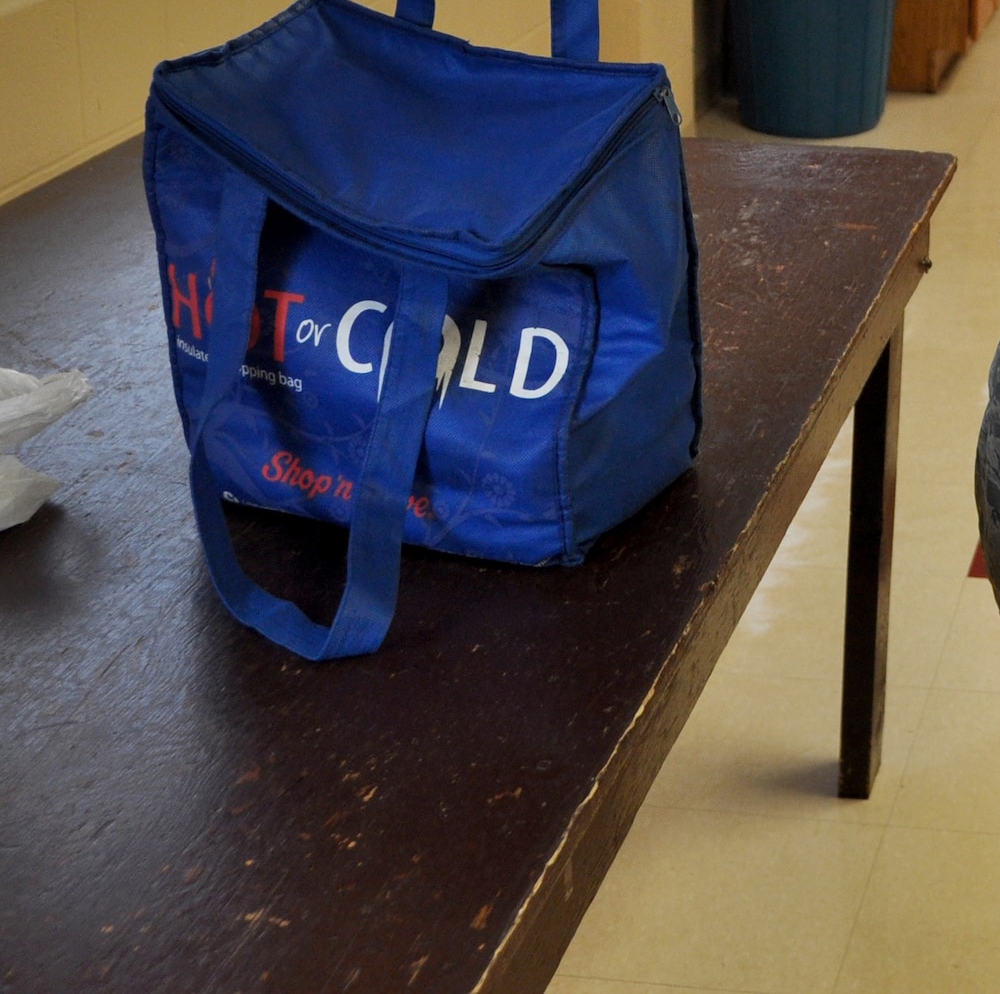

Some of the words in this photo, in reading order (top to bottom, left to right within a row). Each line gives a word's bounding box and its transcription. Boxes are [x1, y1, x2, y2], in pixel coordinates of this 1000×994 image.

[168, 257, 304, 363] HT
[296, 318, 332, 347] or
[279, 371, 303, 393] bag
